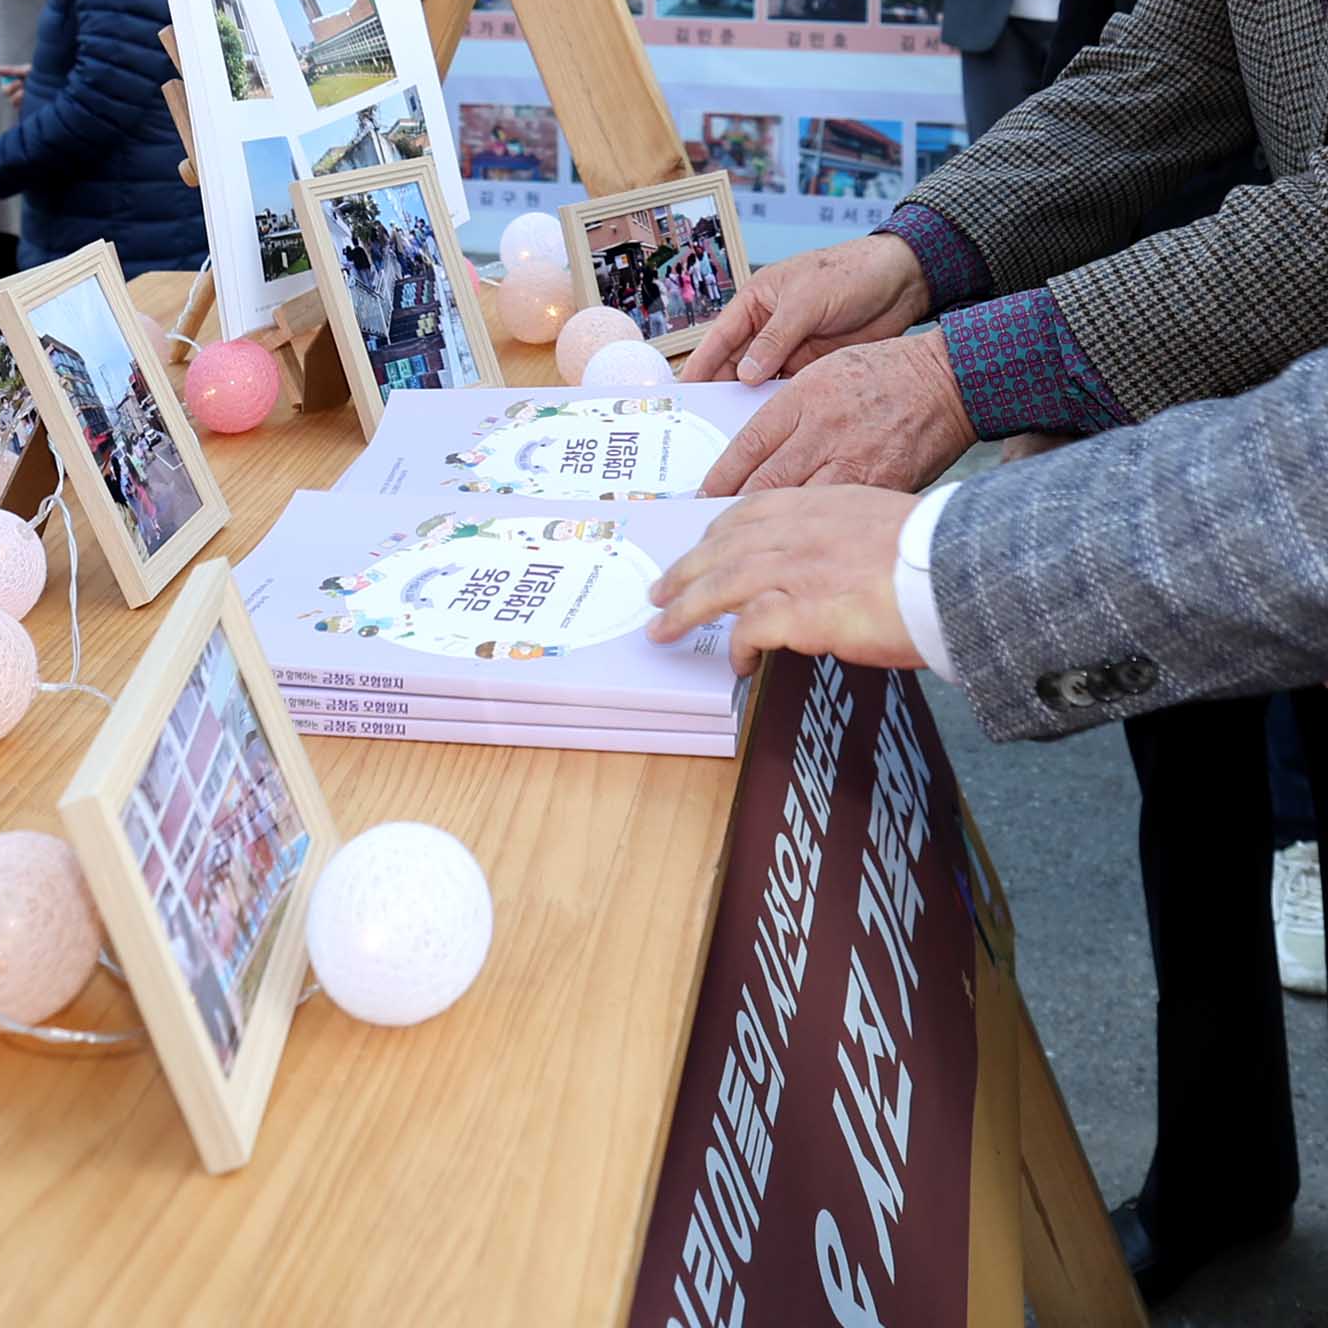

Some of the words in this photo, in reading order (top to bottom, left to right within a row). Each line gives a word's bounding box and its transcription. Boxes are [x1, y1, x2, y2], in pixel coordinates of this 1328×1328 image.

[559, 438, 599, 475] 금창동
[601, 431, 640, 481] 모험일지
[448, 567, 511, 613] 금창동
[494, 562, 565, 624] 모험일지
[322, 673, 355, 687] 금창동
[359, 675, 404, 689] 모험일지
[323, 720, 357, 734] 금창동
[360, 721, 406, 736] 모험일지
[326, 699, 359, 713] 금창동
[363, 700, 409, 715] 모험일지
[755, 783, 822, 1048] 시선으로
[832, 944, 913, 1285] 사진
